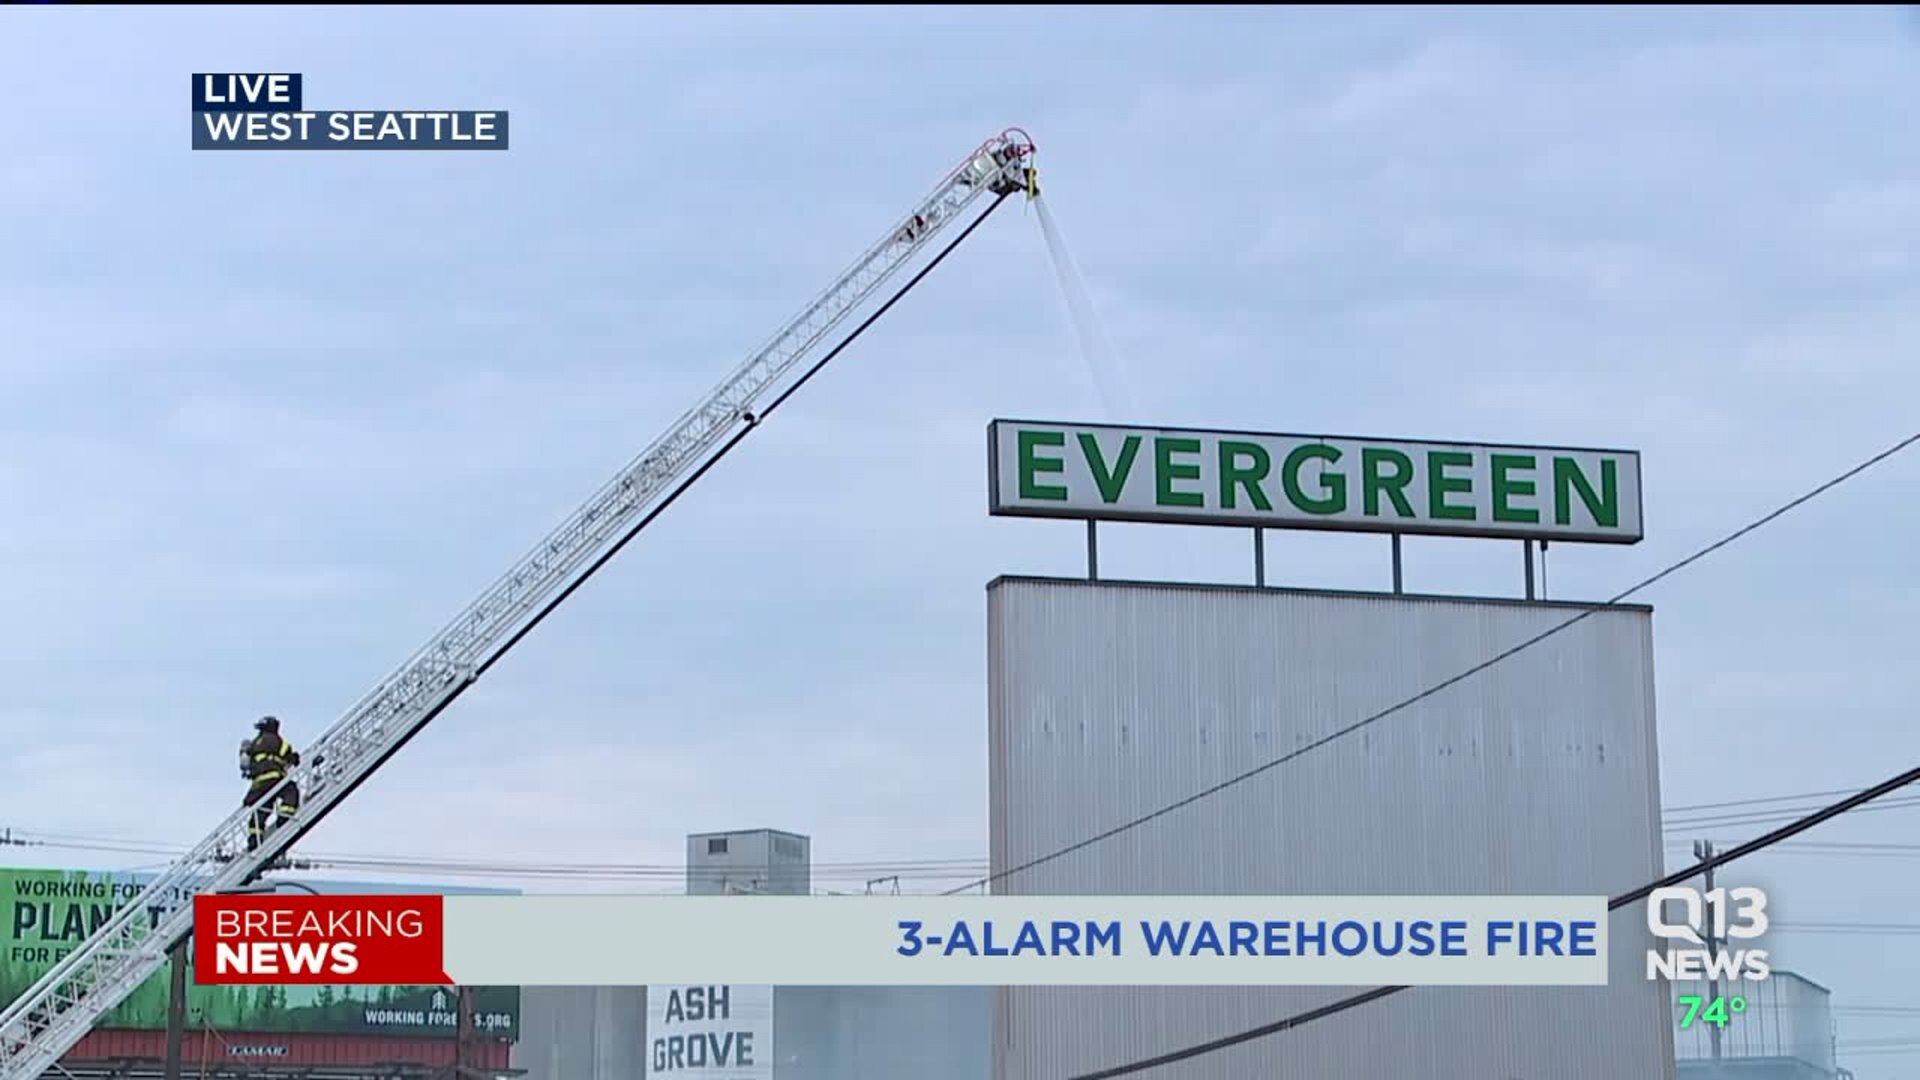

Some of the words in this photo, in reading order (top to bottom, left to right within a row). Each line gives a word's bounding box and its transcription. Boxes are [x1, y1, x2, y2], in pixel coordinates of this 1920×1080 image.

[1017, 429, 1619, 529] EVERGREEN
[15, 879, 105, 898] WORKING
[11, 947, 49, 963] FOR
[664, 985, 730, 1024] ASH
[365, 1010, 424, 1025] WORKING
[428, 1011, 511, 1029] FORES.ORG
[653, 1031, 755, 1072] GROVE
